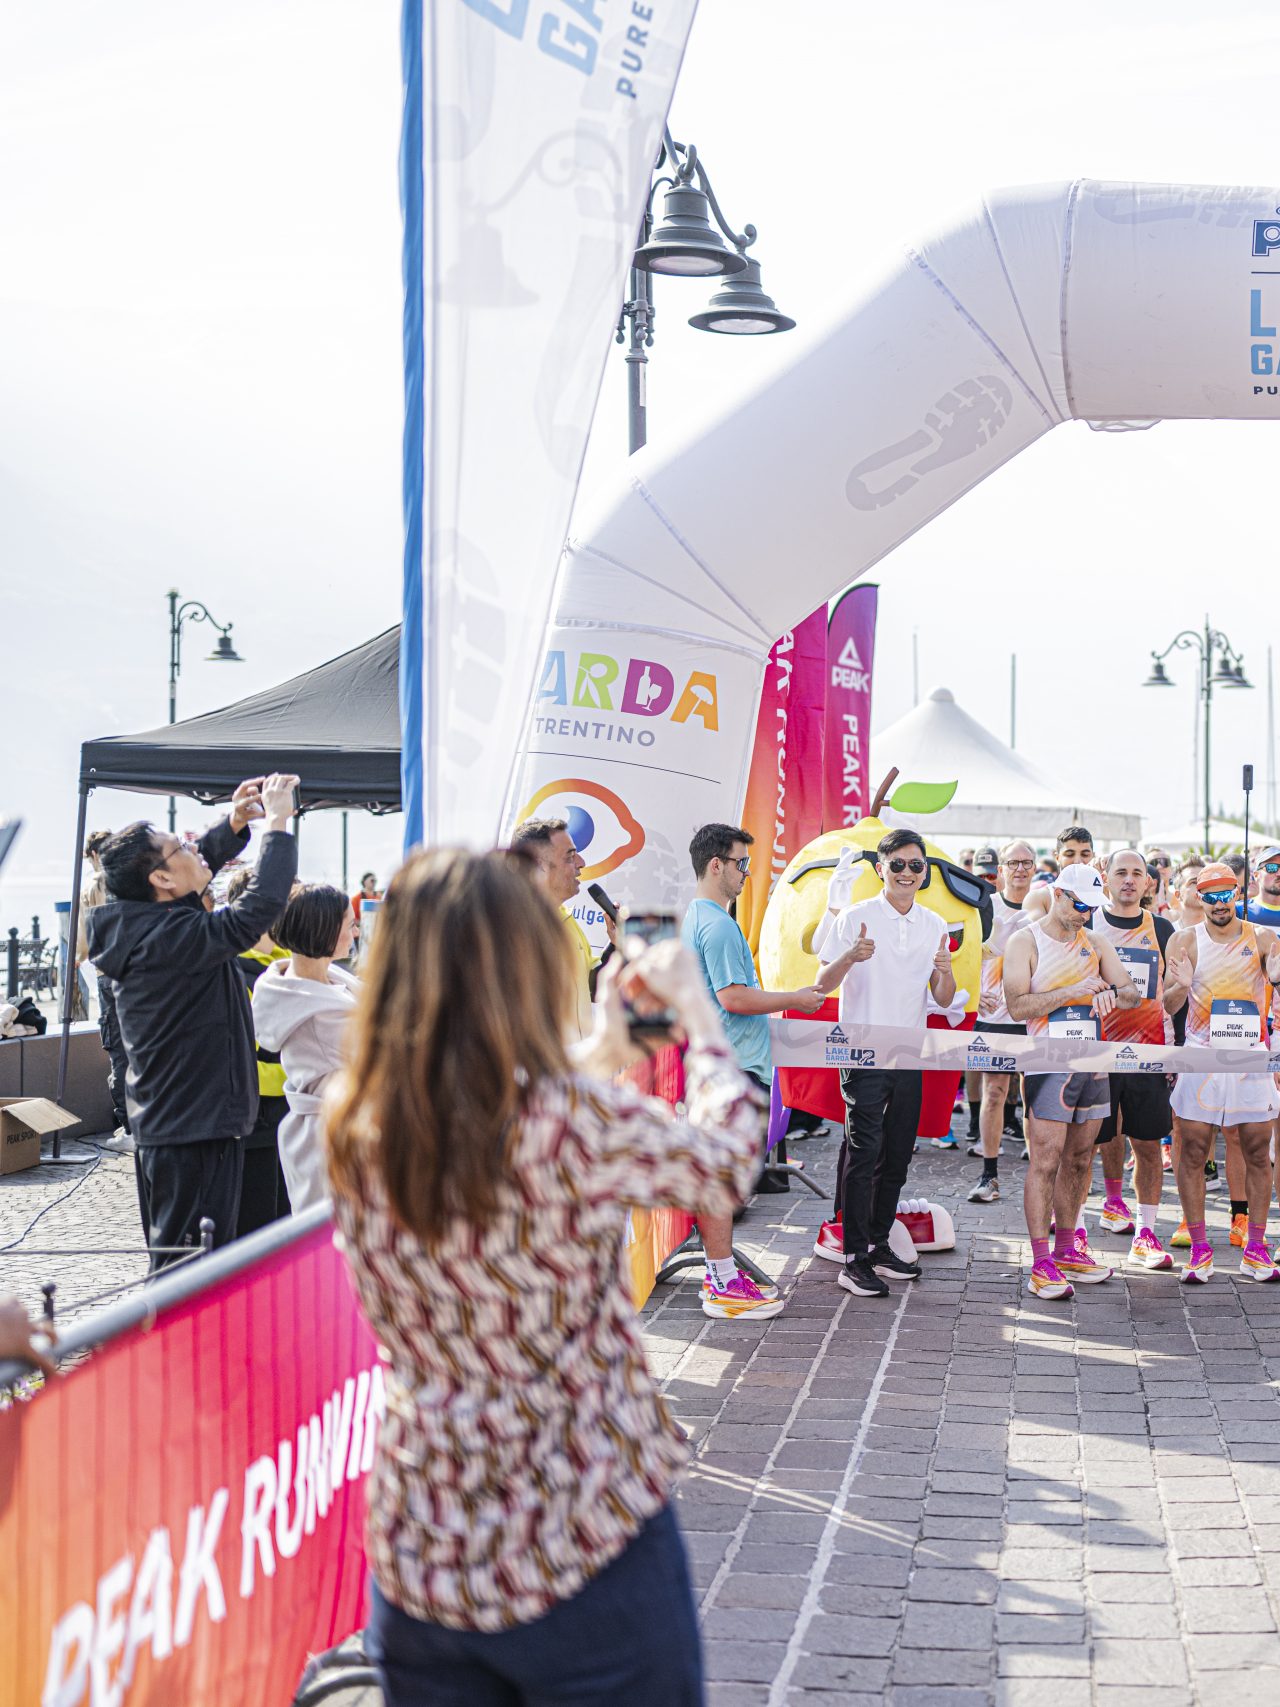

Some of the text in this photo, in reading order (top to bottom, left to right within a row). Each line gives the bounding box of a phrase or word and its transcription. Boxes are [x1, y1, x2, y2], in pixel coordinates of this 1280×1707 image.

[615, 1, 653, 99] PURE
[535, 650, 719, 732] ARDA
[831, 665, 870, 693] PEAK
[535, 717, 656, 747] TRENTINO
[842, 713, 862, 798] PEAK
[826, 1036, 849, 1044] PEAK
[850, 1049, 875, 1066] 42
[991, 1057, 1016, 1070] 42
[1139, 1062, 1164, 1072] 42
[42, 1365, 388, 1707] PEAK RUNNIN
